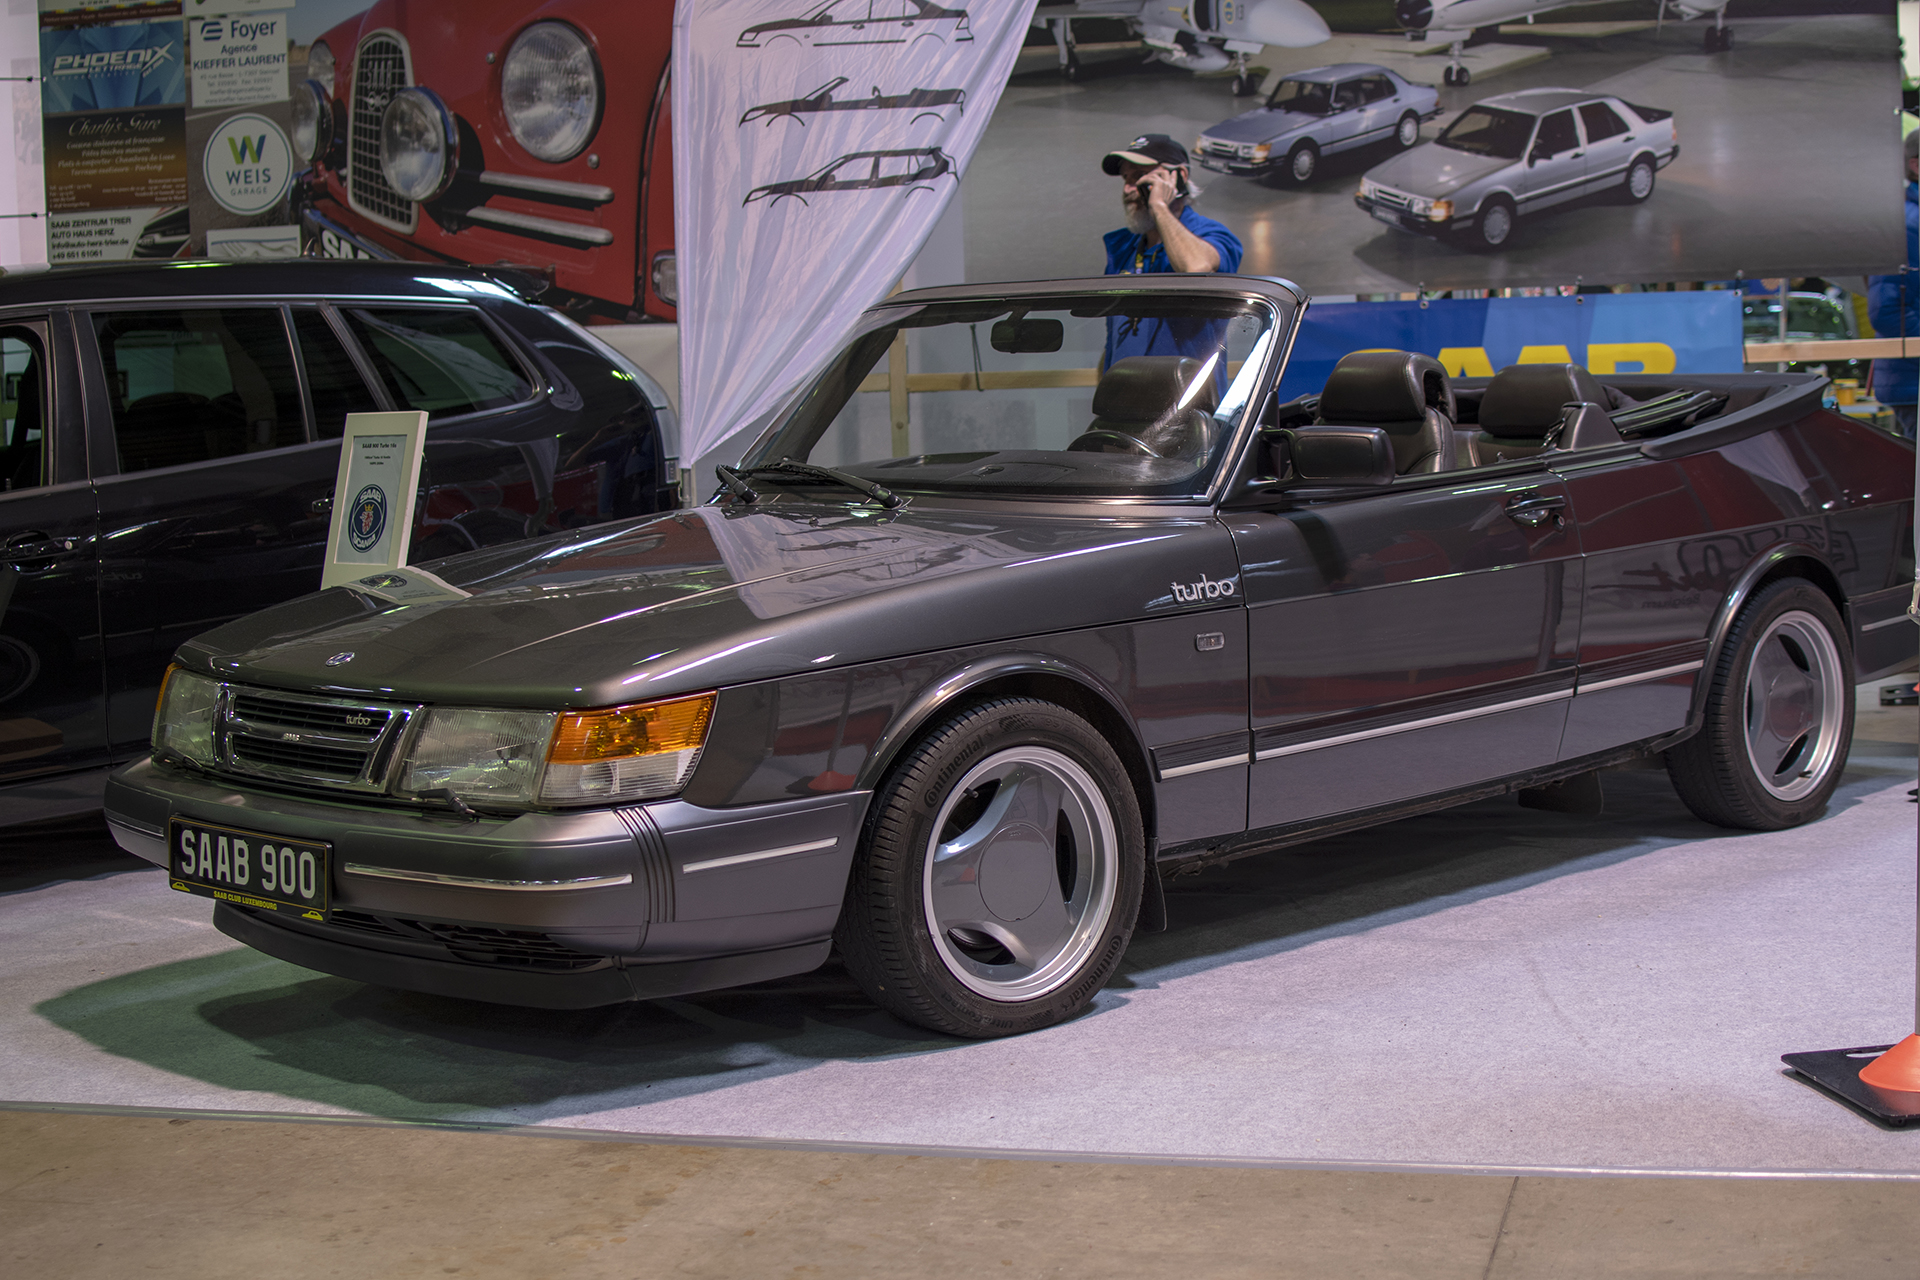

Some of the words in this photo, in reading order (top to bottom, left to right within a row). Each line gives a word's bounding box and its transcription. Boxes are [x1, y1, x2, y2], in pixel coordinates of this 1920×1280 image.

[230, 19, 277, 42] Foyer
[53, 40, 175, 74] PHOENIX
[221, 44, 258, 56] Agence
[193, 57, 235, 70] KIEFFER
[238, 53, 287, 67] LAURENT
[69, 116, 122, 138] Charly's
[130, 113, 161, 132] Gare
[226, 168, 271, 186] WEIS
[230, 186, 268, 197] GARAGE
[51, 220, 70, 229] SAAB
[72, 218, 108, 228] ZENTRUM
[110, 216, 131, 225] TRIER
[51, 231, 71, 240] AUTO
[73, 229, 93, 238] HAUS
[94, 228, 114, 236] HERZ
[360, 488, 382, 503] SAAB
[1170, 573, 1234, 602] turbo
[345, 713, 371, 726] turbo
[924, 734, 985, 808] Continental
[181, 828, 250, 886] SAAB
[260, 844, 317, 899] 900
[213, 890, 227, 900] SAAB
[228, 893, 241, 903] CLUB
[242, 896, 278, 911] LUXEMBOURG
